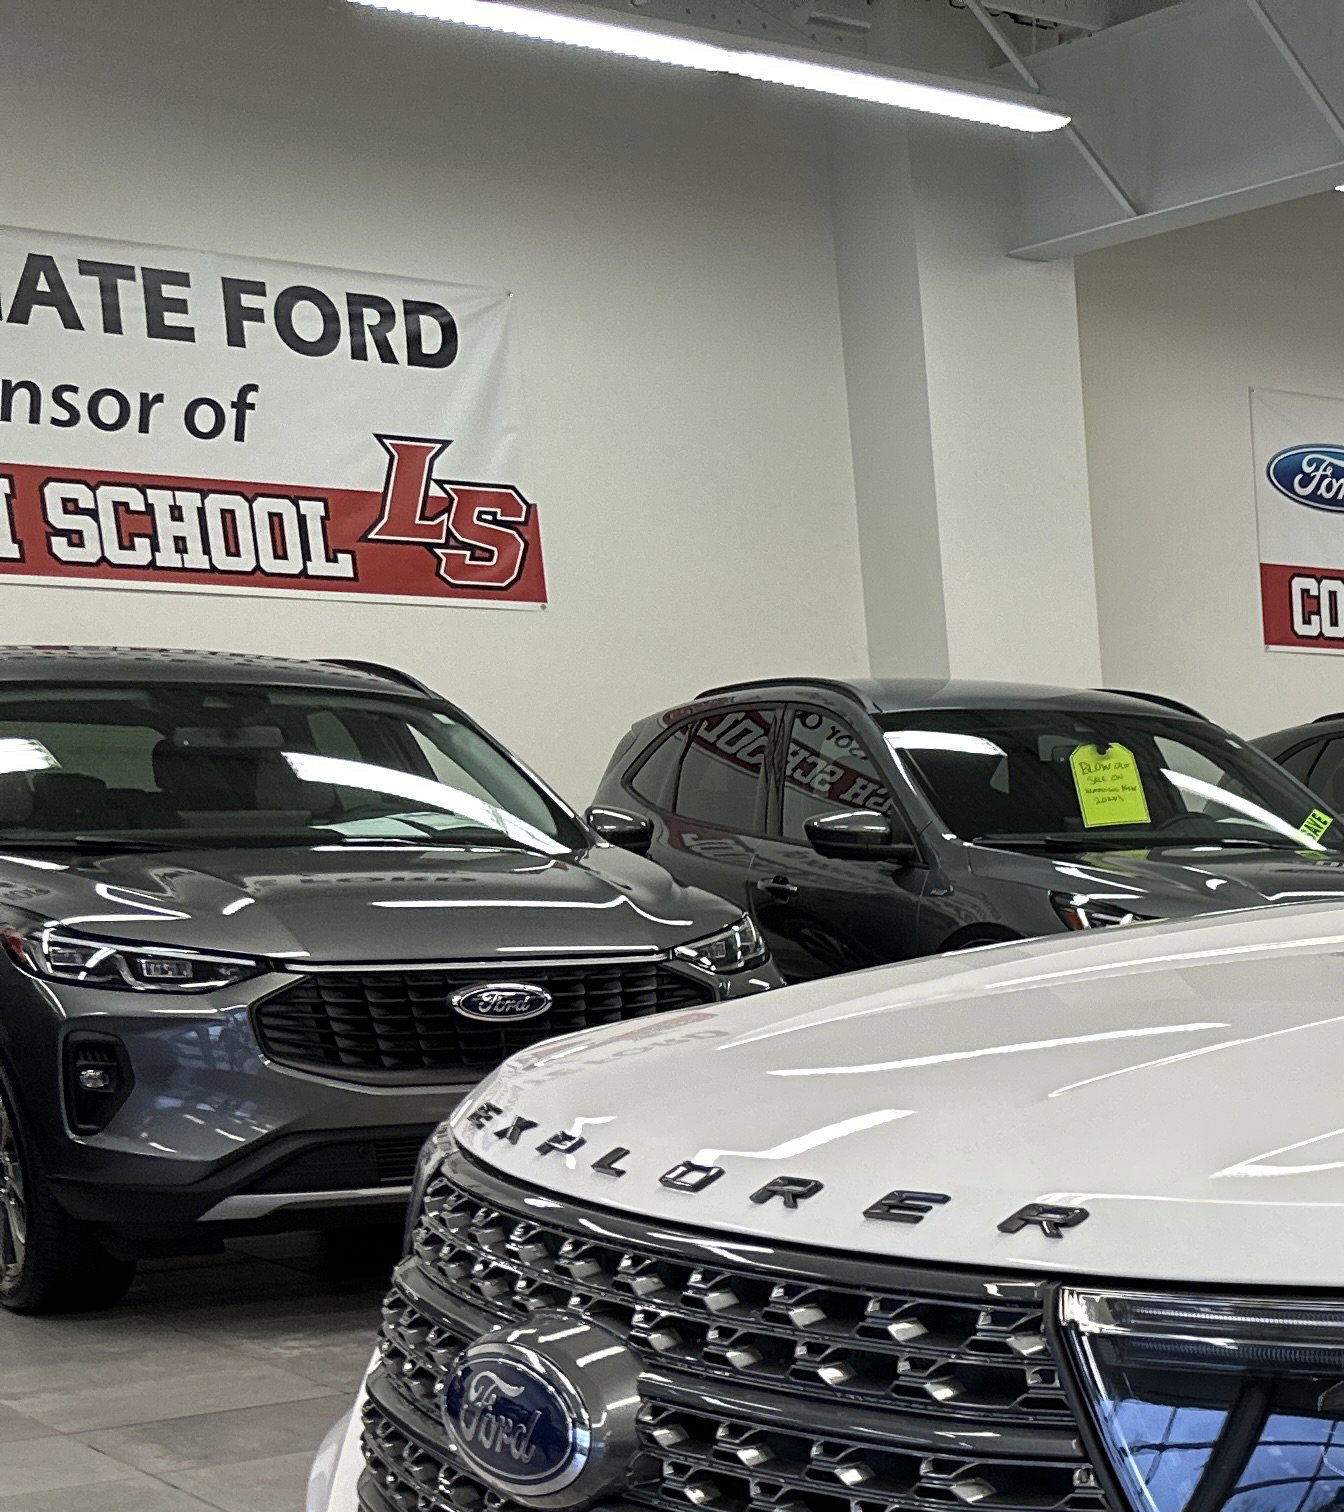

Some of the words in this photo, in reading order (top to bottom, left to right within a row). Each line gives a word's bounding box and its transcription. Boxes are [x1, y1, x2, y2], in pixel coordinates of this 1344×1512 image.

[0, 252, 196, 343] ATE
[220, 276, 459, 369] FORD
[184, 384, 259, 442] of
[40, 478, 359, 581] SCHOOL
[467, 1102, 1090, 1239] EXPLORER
